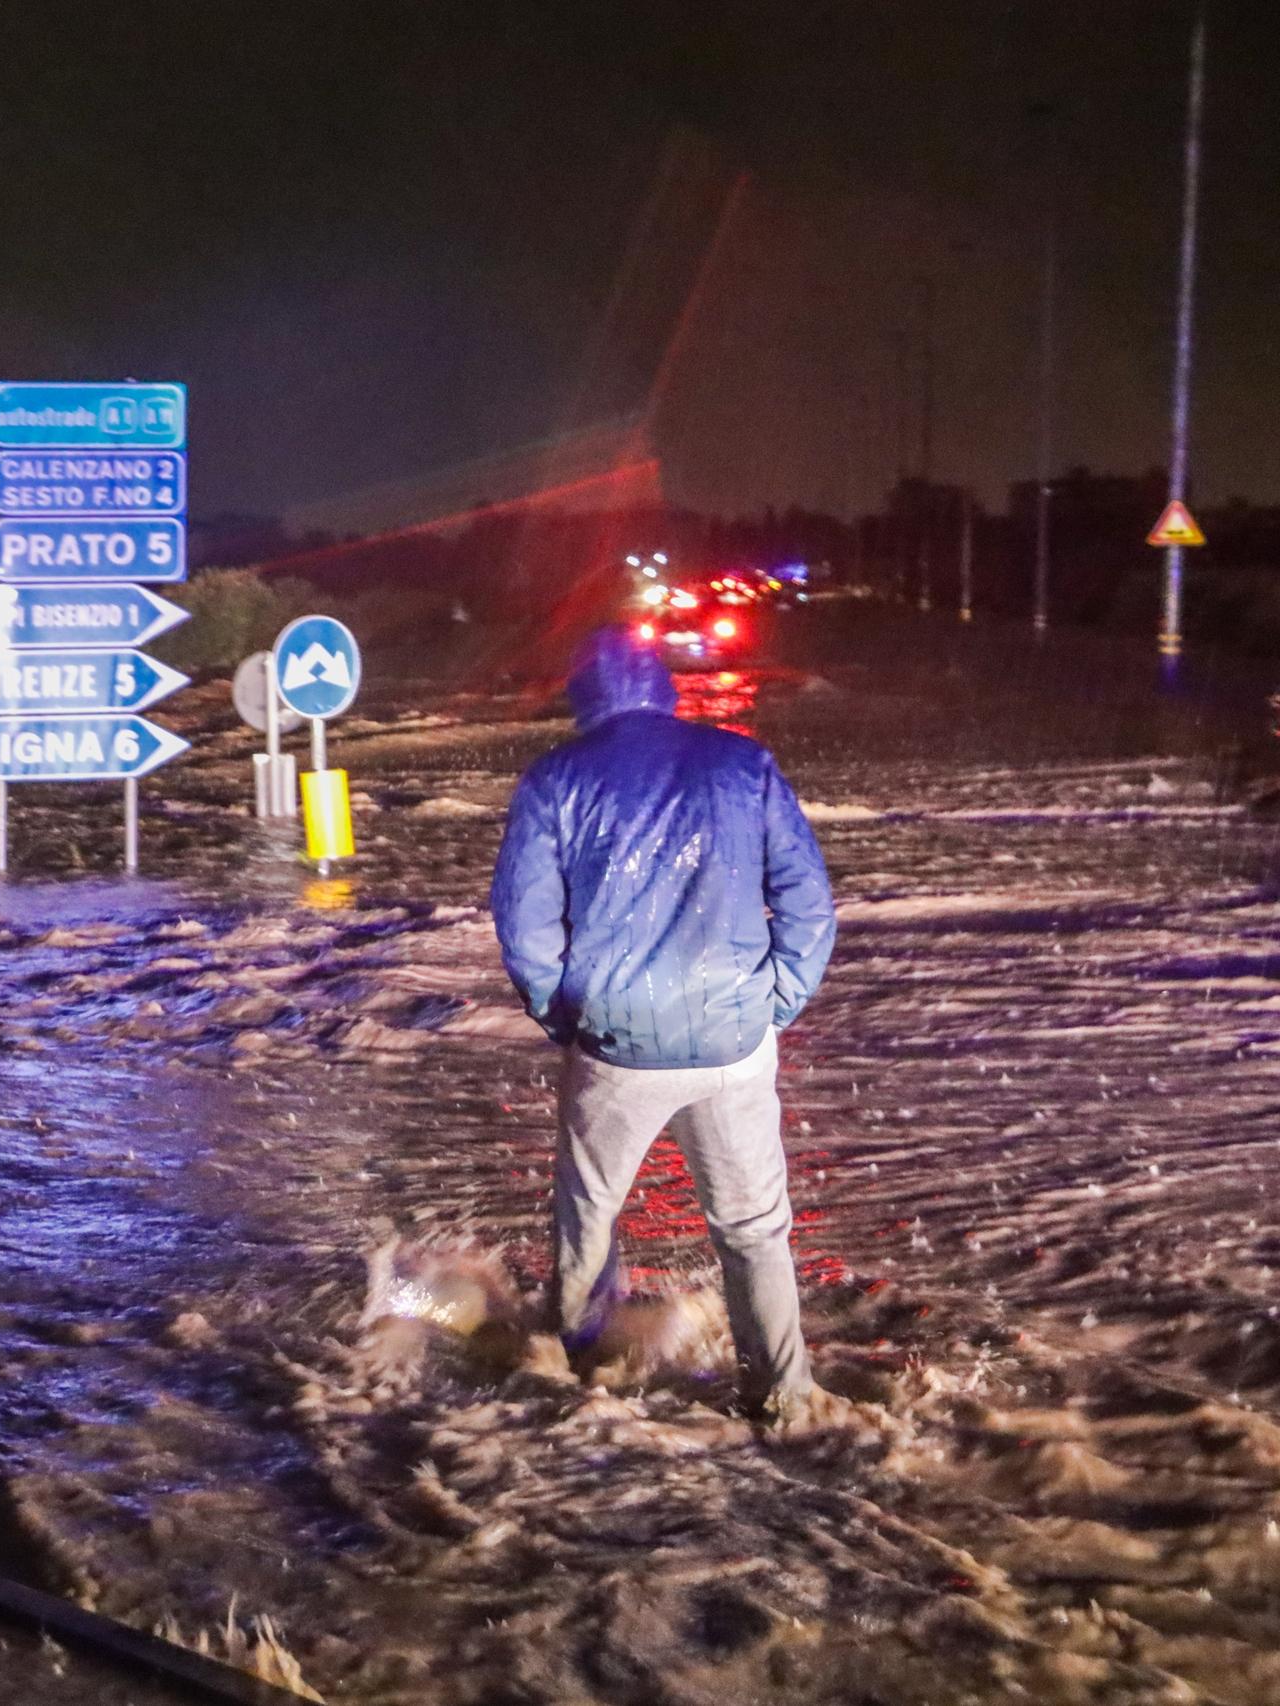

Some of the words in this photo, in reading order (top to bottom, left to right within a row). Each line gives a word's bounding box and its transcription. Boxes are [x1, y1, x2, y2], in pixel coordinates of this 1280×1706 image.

[0, 459, 152, 479] CALENZANO
[157, 460, 174, 479] 2
[3, 486, 85, 506] SESTO
[155, 486, 174, 506] 4
[1, 533, 135, 566] PRATO
[148, 532, 172, 564] 5
[32, 604, 123, 627] BISENZIO
[128, 604, 139, 626] 1
[115, 663, 136, 697] 5
[113, 729, 140, 761] 6
